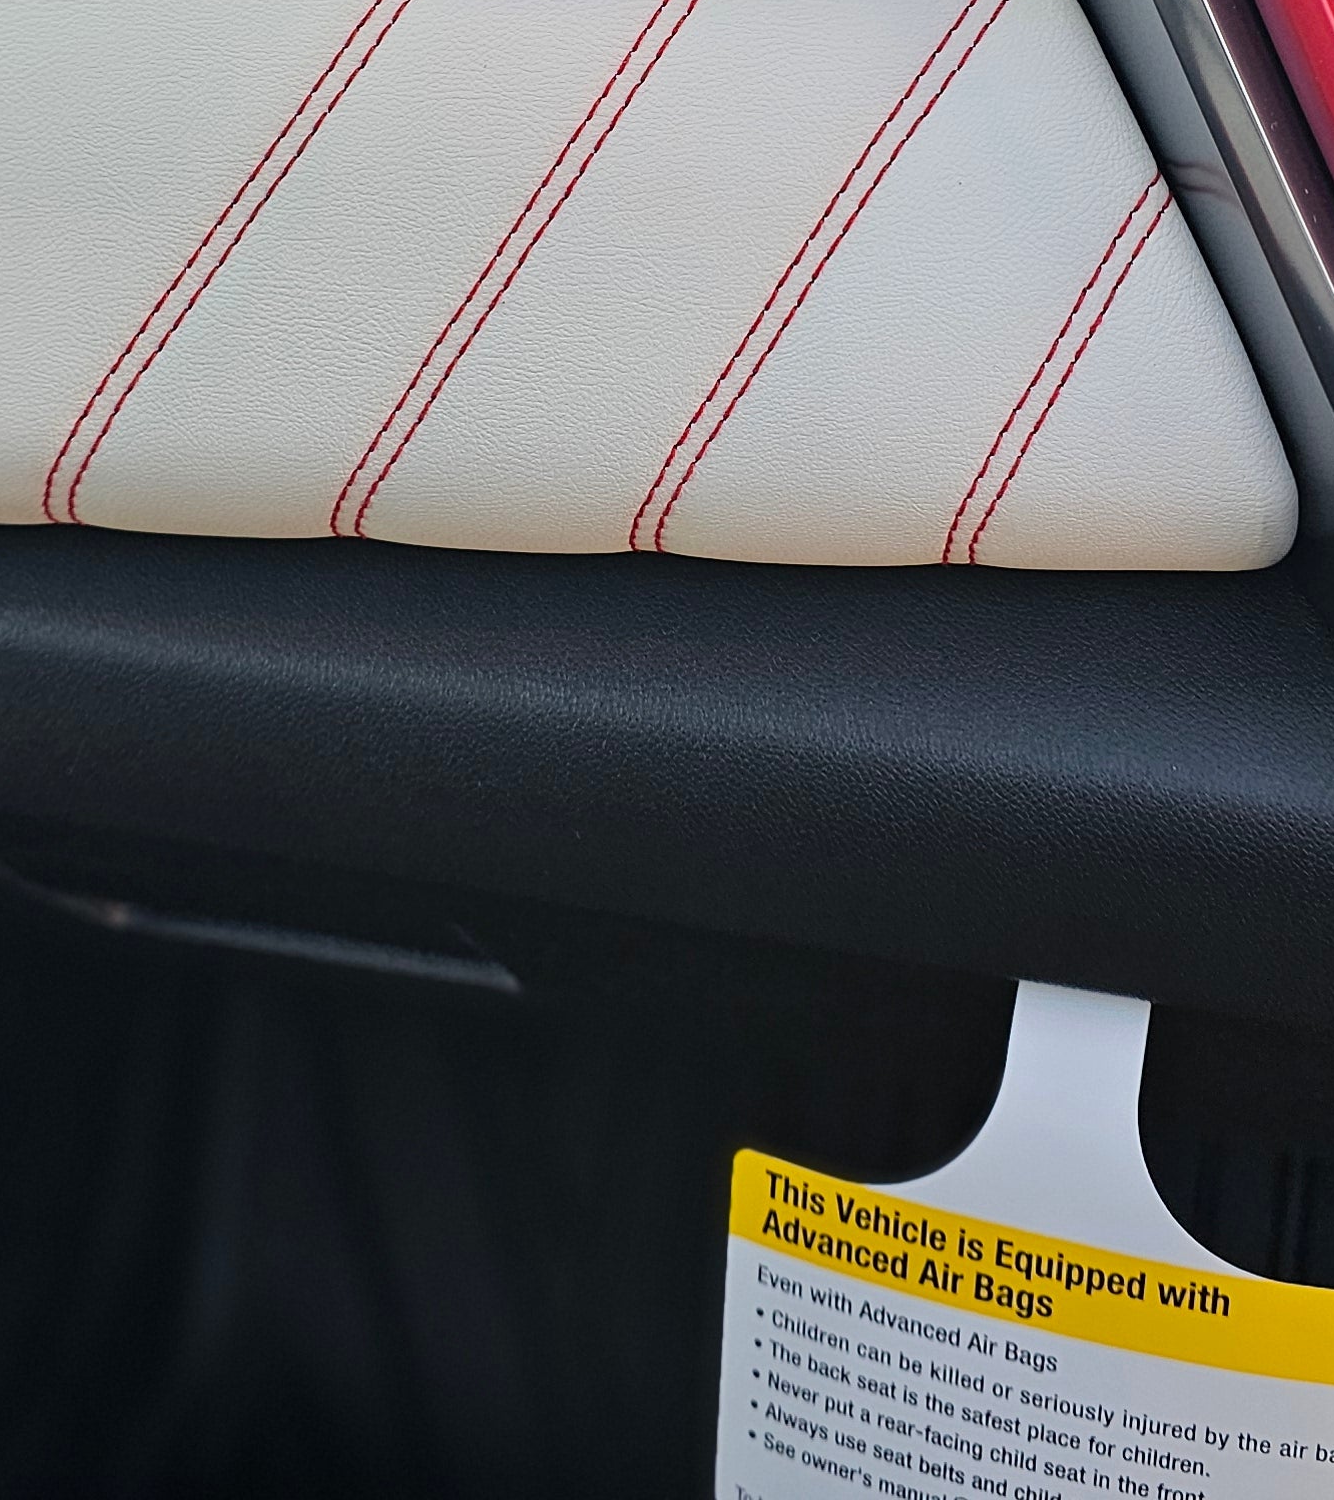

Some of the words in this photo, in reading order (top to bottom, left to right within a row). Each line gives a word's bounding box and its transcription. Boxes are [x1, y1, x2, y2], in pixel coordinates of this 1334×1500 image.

[762, 1208, 909, 1280] Advanced
[918, 1258, 964, 1295] Air
[974, 1272, 1054, 1319] Bags
[766, 1169, 825, 1215] This
[835, 1192, 947, 1252] Vehicle
[957, 1228, 984, 1261] is
[995, 1237, 1147, 1301] Equipped
[1157, 1281, 1231, 1317] with
[757, 1263, 803, 1298] Even
[810, 1286, 853, 1315] with
[859, 1300, 962, 1347] Advanced
[968, 1332, 998, 1357] Air
[1005, 1340, 1058, 1372] Bags
[767, 1369, 820, 1405] Never
[824, 1394, 854, 1418] put
[860, 1407, 871, 1423] a
[876, 1411, 984, 1462] rear-facing
[989, 1446, 1037, 1472] child
[1043, 1460, 1086, 1484] seat
[1093, 1468, 1110, 1490] in
[1118, 1475, 1149, 1497] the
[768, 1338, 802, 1367] The
[807, 1353, 851, 1385] back
[857, 1373, 897, 1400] seat
[902, 1384, 918, 1405] is
[925, 1392, 955, 1416] the
[961, 1405, 1021, 1436] safest
[1027, 1421, 1081, 1450] place
[1088, 1435, 1116, 1458] for
[1122, 1445, 1211, 1478] children.
[771, 1308, 850, 1352] Children
[857, 1341, 891, 1366] can
[898, 1351, 923, 1374] be
[930, 1360, 985, 1393] killed
[992, 1381, 1013, 1400] or
[1020, 1389, 1114, 1428] seriously
[1122, 1409, 1197, 1441] injured
[1205, 1426, 1230, 1451] by
[1237, 1432, 1271, 1455] the
[1279, 1440, 1309, 1460] air
[764, 1431, 796, 1459] See
[801, 1450, 873, 1488] owner's
[765, 1401, 829, 1441] Always
[834, 1430, 867, 1453] use
[873, 1443, 912, 1469] seat
[919, 1454, 965, 1485] belts
[972, 1475, 1007, 1497] and
